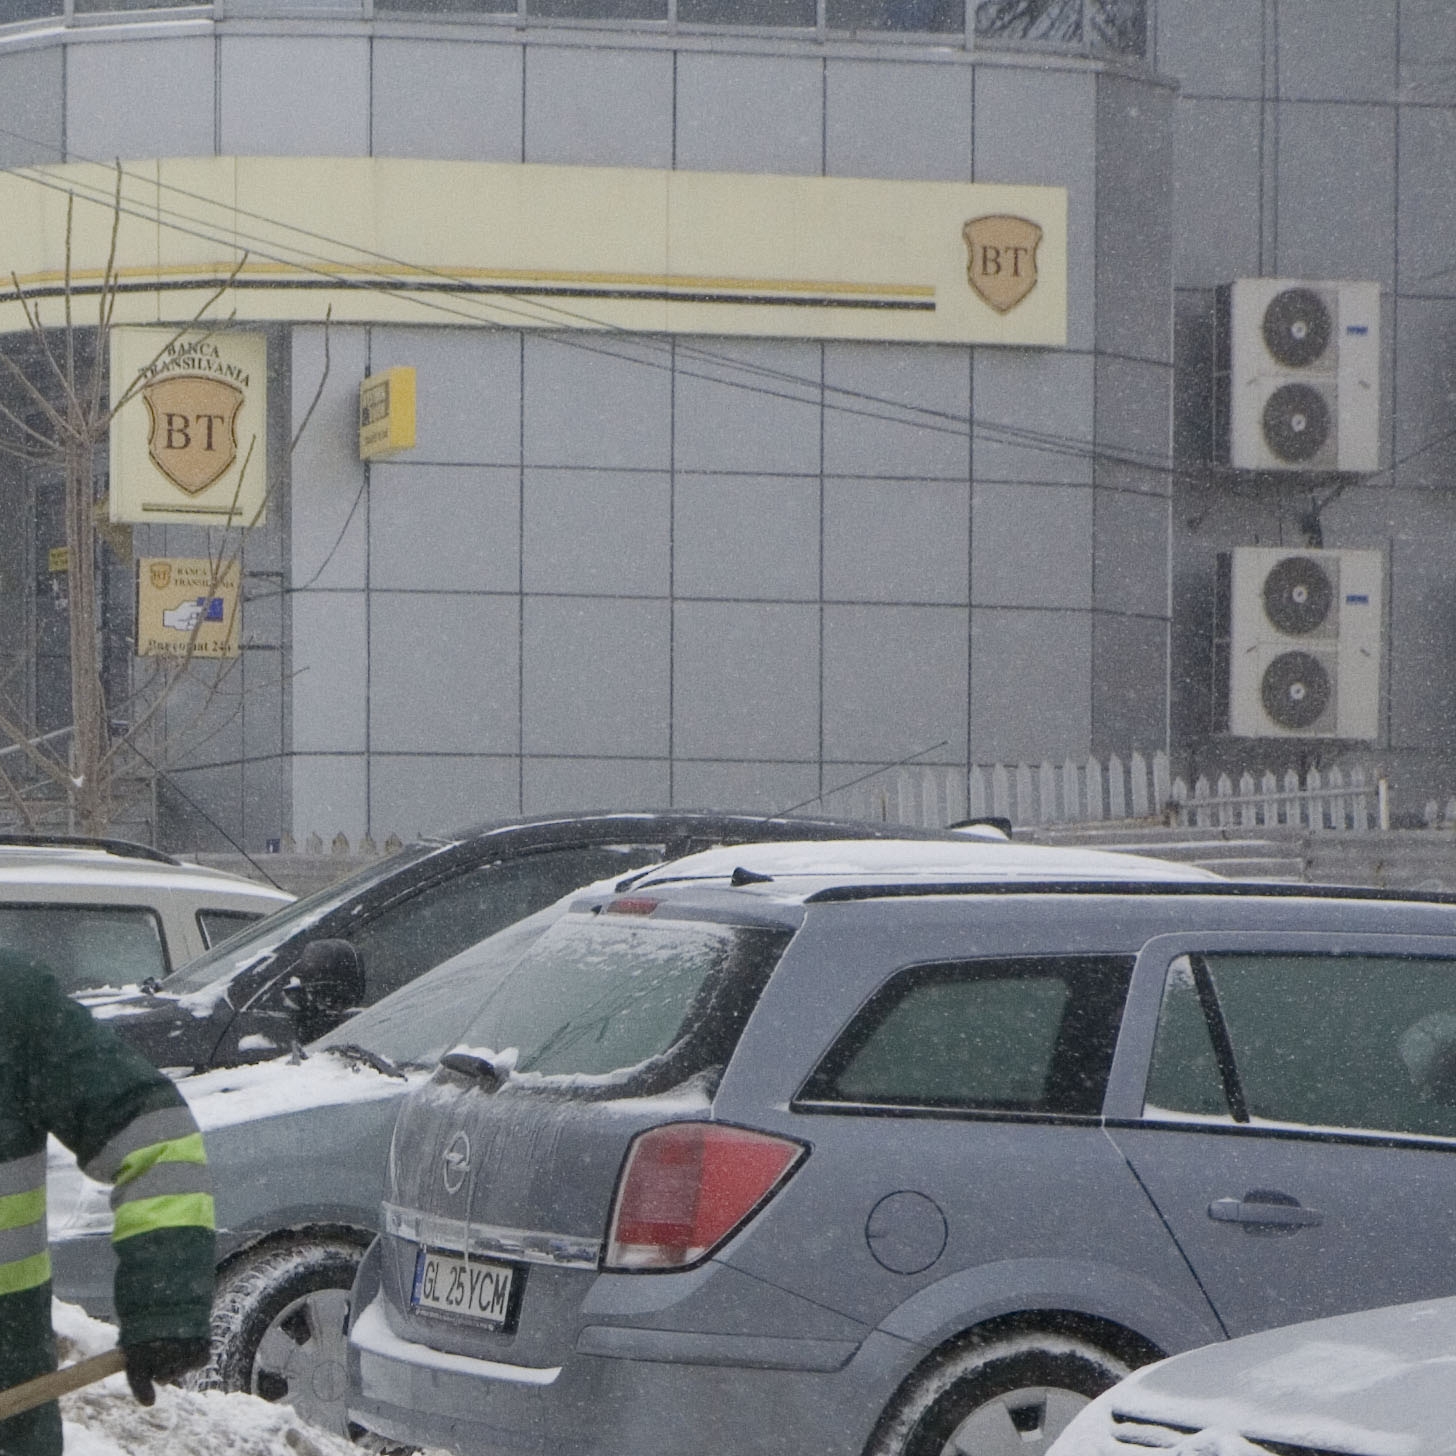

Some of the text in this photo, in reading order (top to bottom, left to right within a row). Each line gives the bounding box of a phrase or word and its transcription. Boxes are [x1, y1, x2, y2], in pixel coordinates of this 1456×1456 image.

[981, 246, 1028, 277] BT
[167, 342, 220, 358] BANCA
[138, 356, 251, 387] TRANSILVANIA
[162, 412, 225, 451] BT
[423, 1261, 440, 1302] GL
